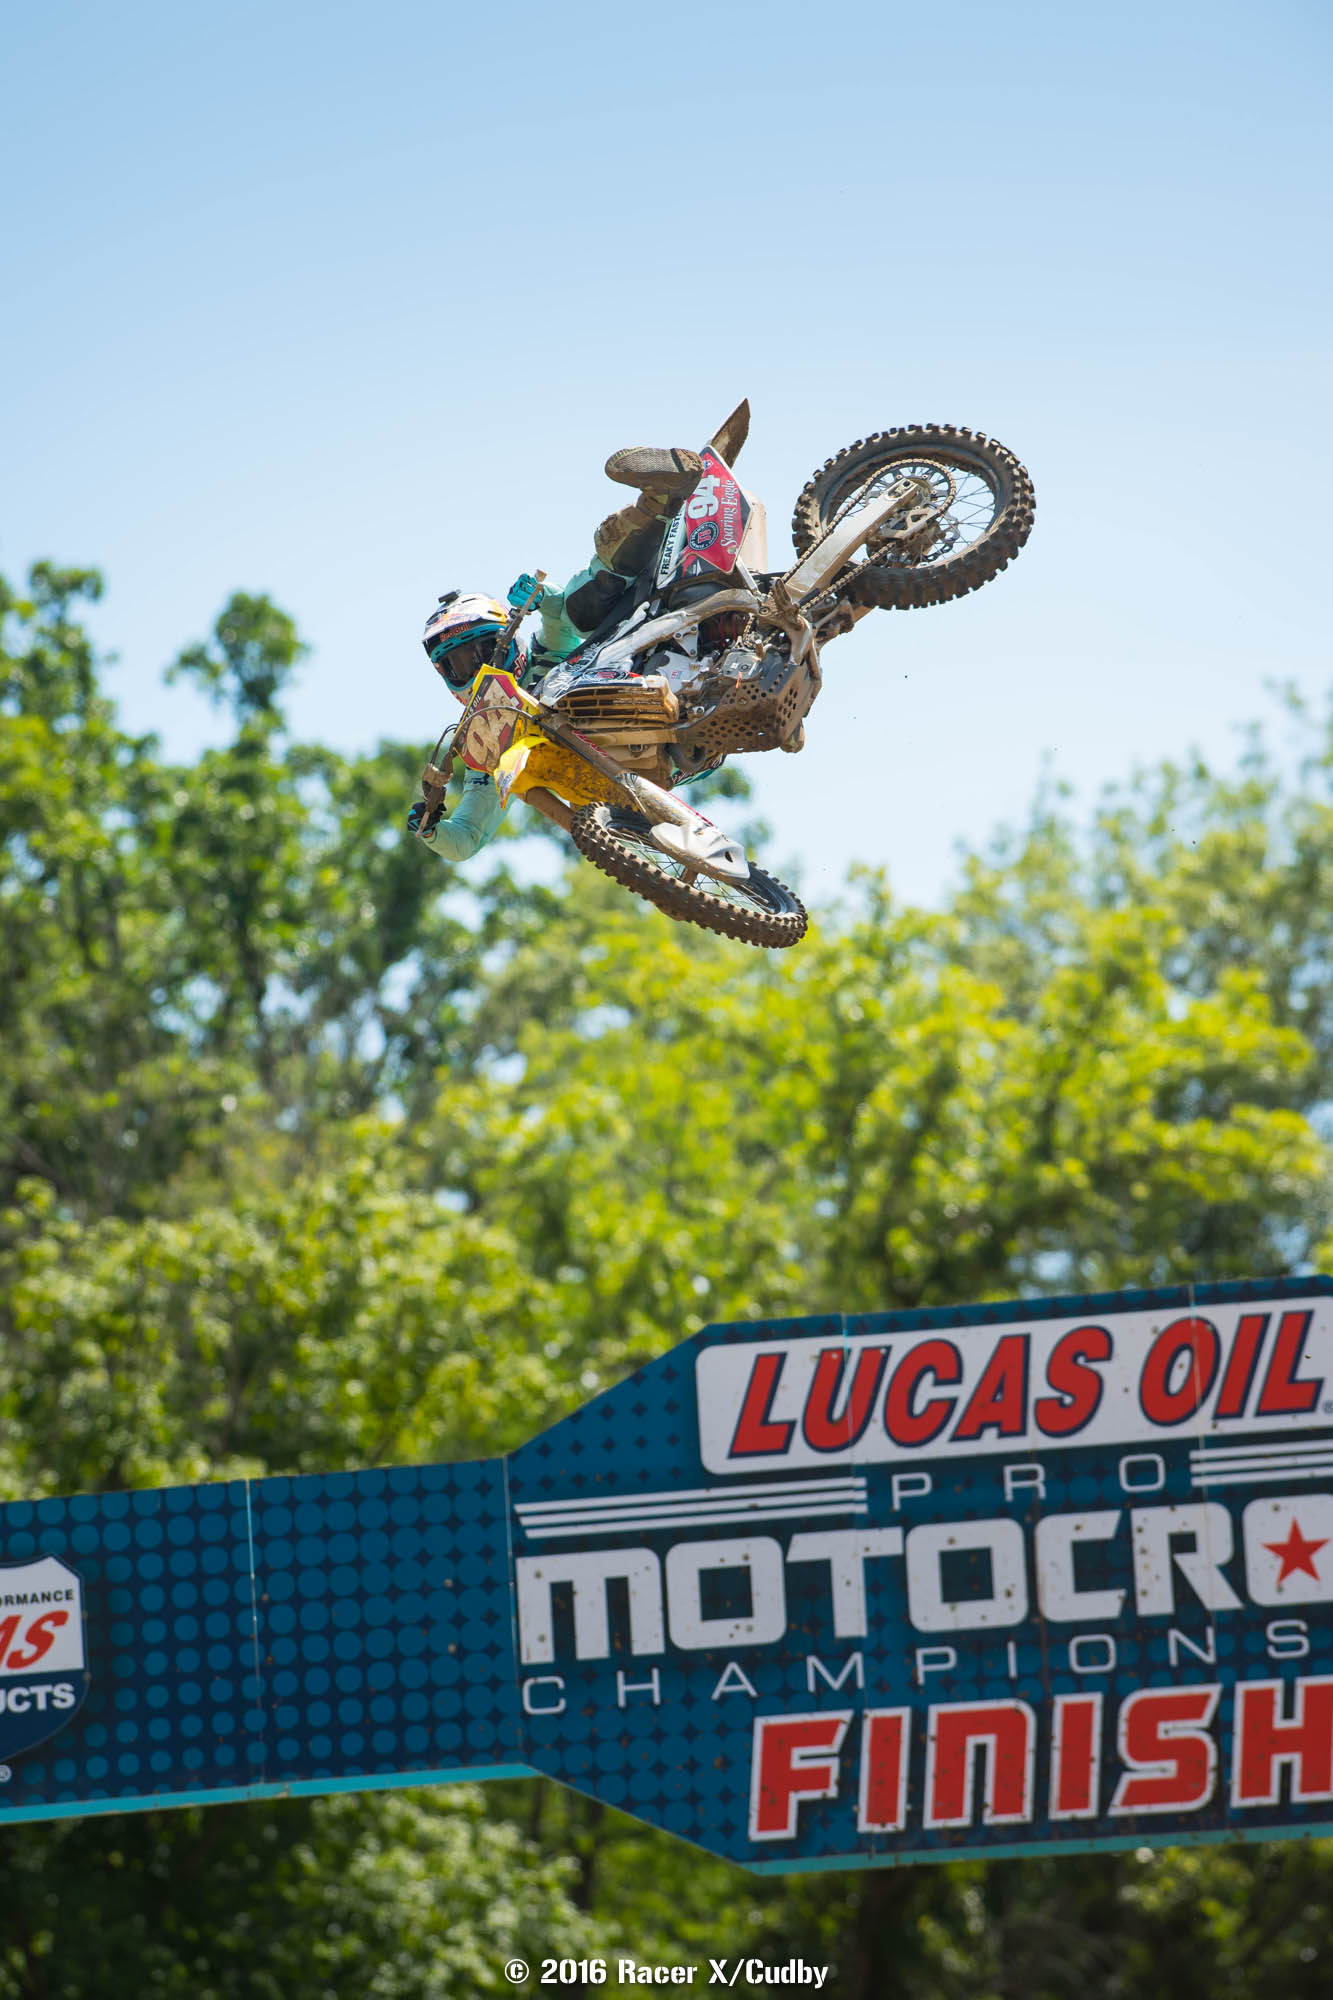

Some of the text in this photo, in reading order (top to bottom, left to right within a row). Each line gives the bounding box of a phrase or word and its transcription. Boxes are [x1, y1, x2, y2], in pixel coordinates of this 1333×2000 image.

[687, 474, 721, 519] 94
[720, 479, 739, 547] Soaring Eagle
[660, 540, 675, 575] FREAKY
[727, 1309, 1325, 1459] LUCAS OIL
[890, 1453, 1166, 1512] PRO
[522, 1619, 1310, 1716] CHAMPIONS
[748, 1674, 1333, 1842] FINISH
